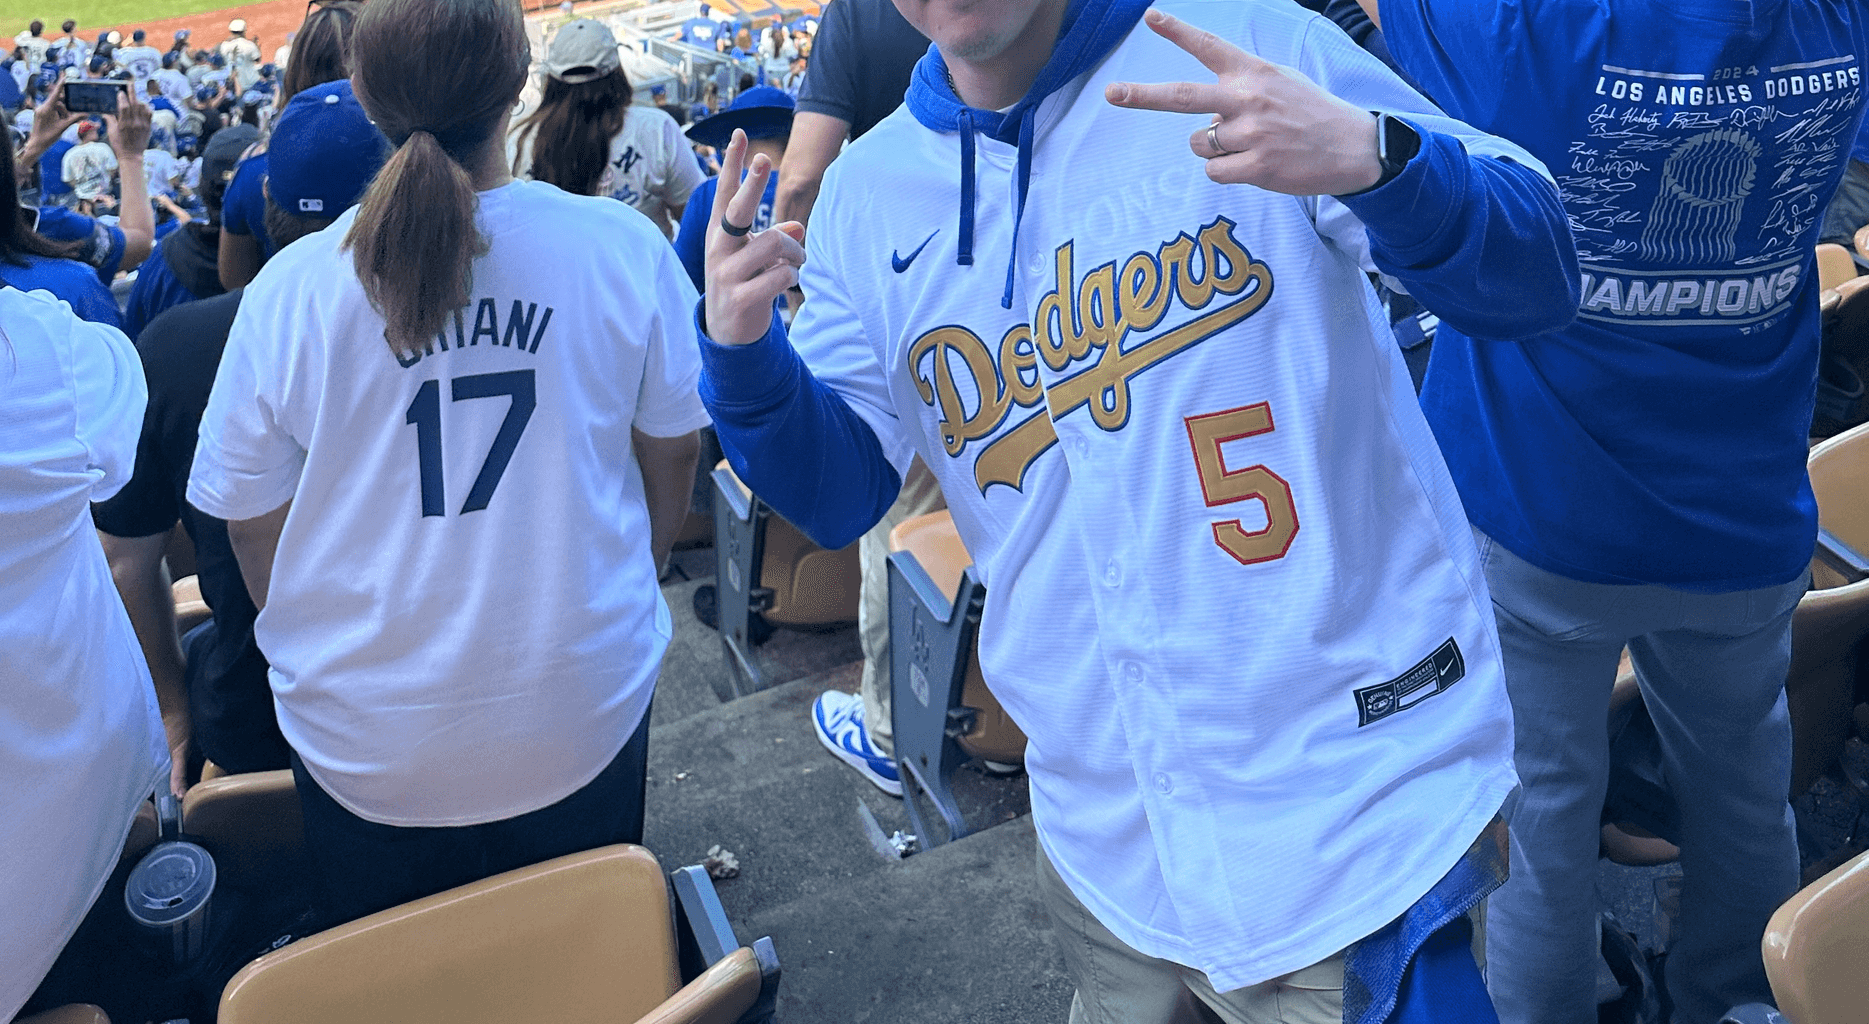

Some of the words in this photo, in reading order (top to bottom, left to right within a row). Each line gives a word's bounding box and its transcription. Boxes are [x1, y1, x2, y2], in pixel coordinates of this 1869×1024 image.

[1595, 76, 1643, 102] LOS
[1655, 83, 1753, 106] ANGELES
[1765, 67, 1860, 100] DODGERS
[1713, 65, 1759, 80] 2024
[908, 214, 1274, 460] Dodgers
[1580, 264, 1801, 316] AMPIONS
[406, 369, 537, 518] 17
[1184, 401, 1300, 565] 5
